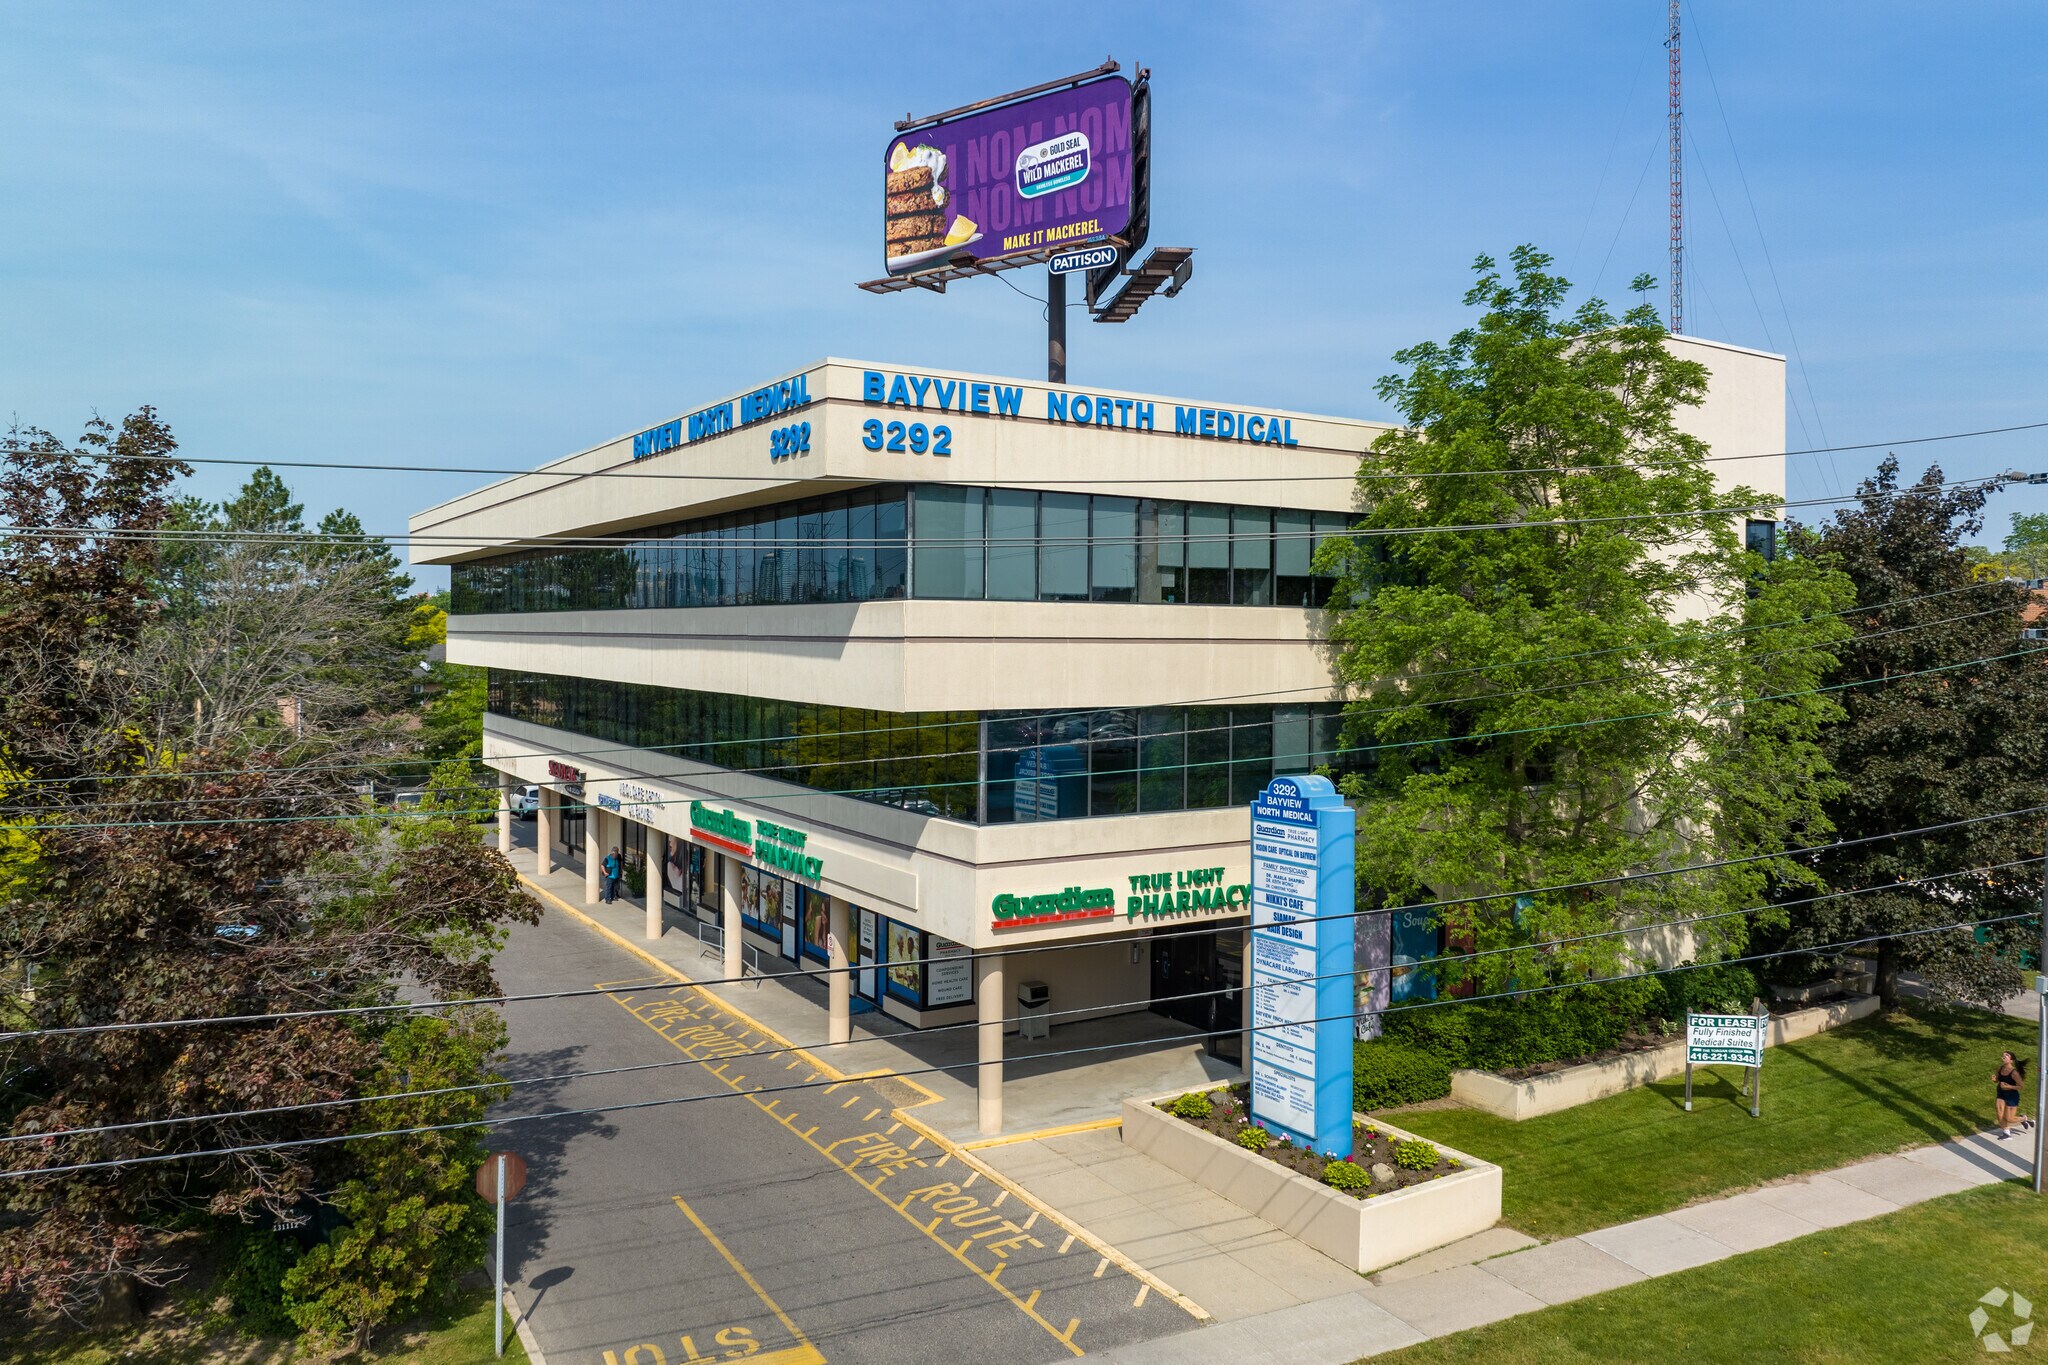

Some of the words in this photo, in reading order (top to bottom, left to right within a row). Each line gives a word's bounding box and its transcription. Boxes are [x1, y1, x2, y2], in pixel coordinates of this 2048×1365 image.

[1050, 142, 1065, 155] GOLD
[1066, 137, 1081, 150] SEAL
[1023, 167, 1043, 184] WILD
[1044, 154, 1084, 178] MACKEREL
[1003, 234, 1031, 251] MAKE
[1034, 231, 1044, 245] IT
[1046, 219, 1104, 243] MACKEREL.
[1054, 249, 1112, 271] PATTISON
[633, 419, 682, 460] BAYVIEW
[688, 402, 733, 441] NORTH
[740, 373, 811, 426] MEDICAL
[863, 371, 1024, 416] BAYVIEW
[1047, 391, 1155, 431] NORTH
[1174, 405, 1299, 446] MEDICAL
[770, 421, 812, 460] 3292
[862, 418, 953, 457] 3292
[1273, 784, 1297, 797] 3292
[1267, 796, 1302, 809] BAYVIEW
[690, 800, 752, 845] Guardian
[1257, 806, 1281, 818] NORTH
[1282, 809, 1313, 822] MEDICAL
[1256, 824, 1286, 836] Guardian
[1287, 834, 1315, 844] PHARMACY
[755, 839, 824, 882] PHARMACY
[1268, 845, 1278, 854] CARE
[1278, 847, 1294, 857] OPTICAL
[1294, 849, 1300, 858] ON
[1300, 851, 1316, 861] BAYVIEW
[1263, 862, 1278, 870] FAMILY
[1279, 866, 1308, 876] PHYSICIANS
[1129, 872, 1172, 891] TRUE
[1178, 867, 1225, 888] LIGHT
[992, 886, 1115, 919] Guardian
[1127, 883, 1251, 919] PHARMACY
[1266, 893, 1287, 907] NIKKI'S
[1288, 898, 1304, 910] CAFE
[1281, 926, 1303, 940] DESIGN
[936, 965, 964, 973] COMPOUNDING
[1256, 958, 1281, 970] DYNACARE
[1282, 966, 1314, 978] LABORATORY
[644, 999, 690, 1028] FIRE
[678, 1020, 757, 1060] ROUTE
[1691, 1017, 1715, 1026] FOR
[1718, 1019, 1755, 1028] LEASE
[1693, 1028, 1713, 1037] Fully
[1716, 1029, 1752, 1037] Finished
[1693, 1038, 1725, 1046] Medical
[1727, 1039, 1753, 1047] Suites
[1690, 1052, 1755, 1063] 416-221-9348
[839, 1131, 928, 1178] FIRE
[911, 1181, 1045, 1260] ROUTE
